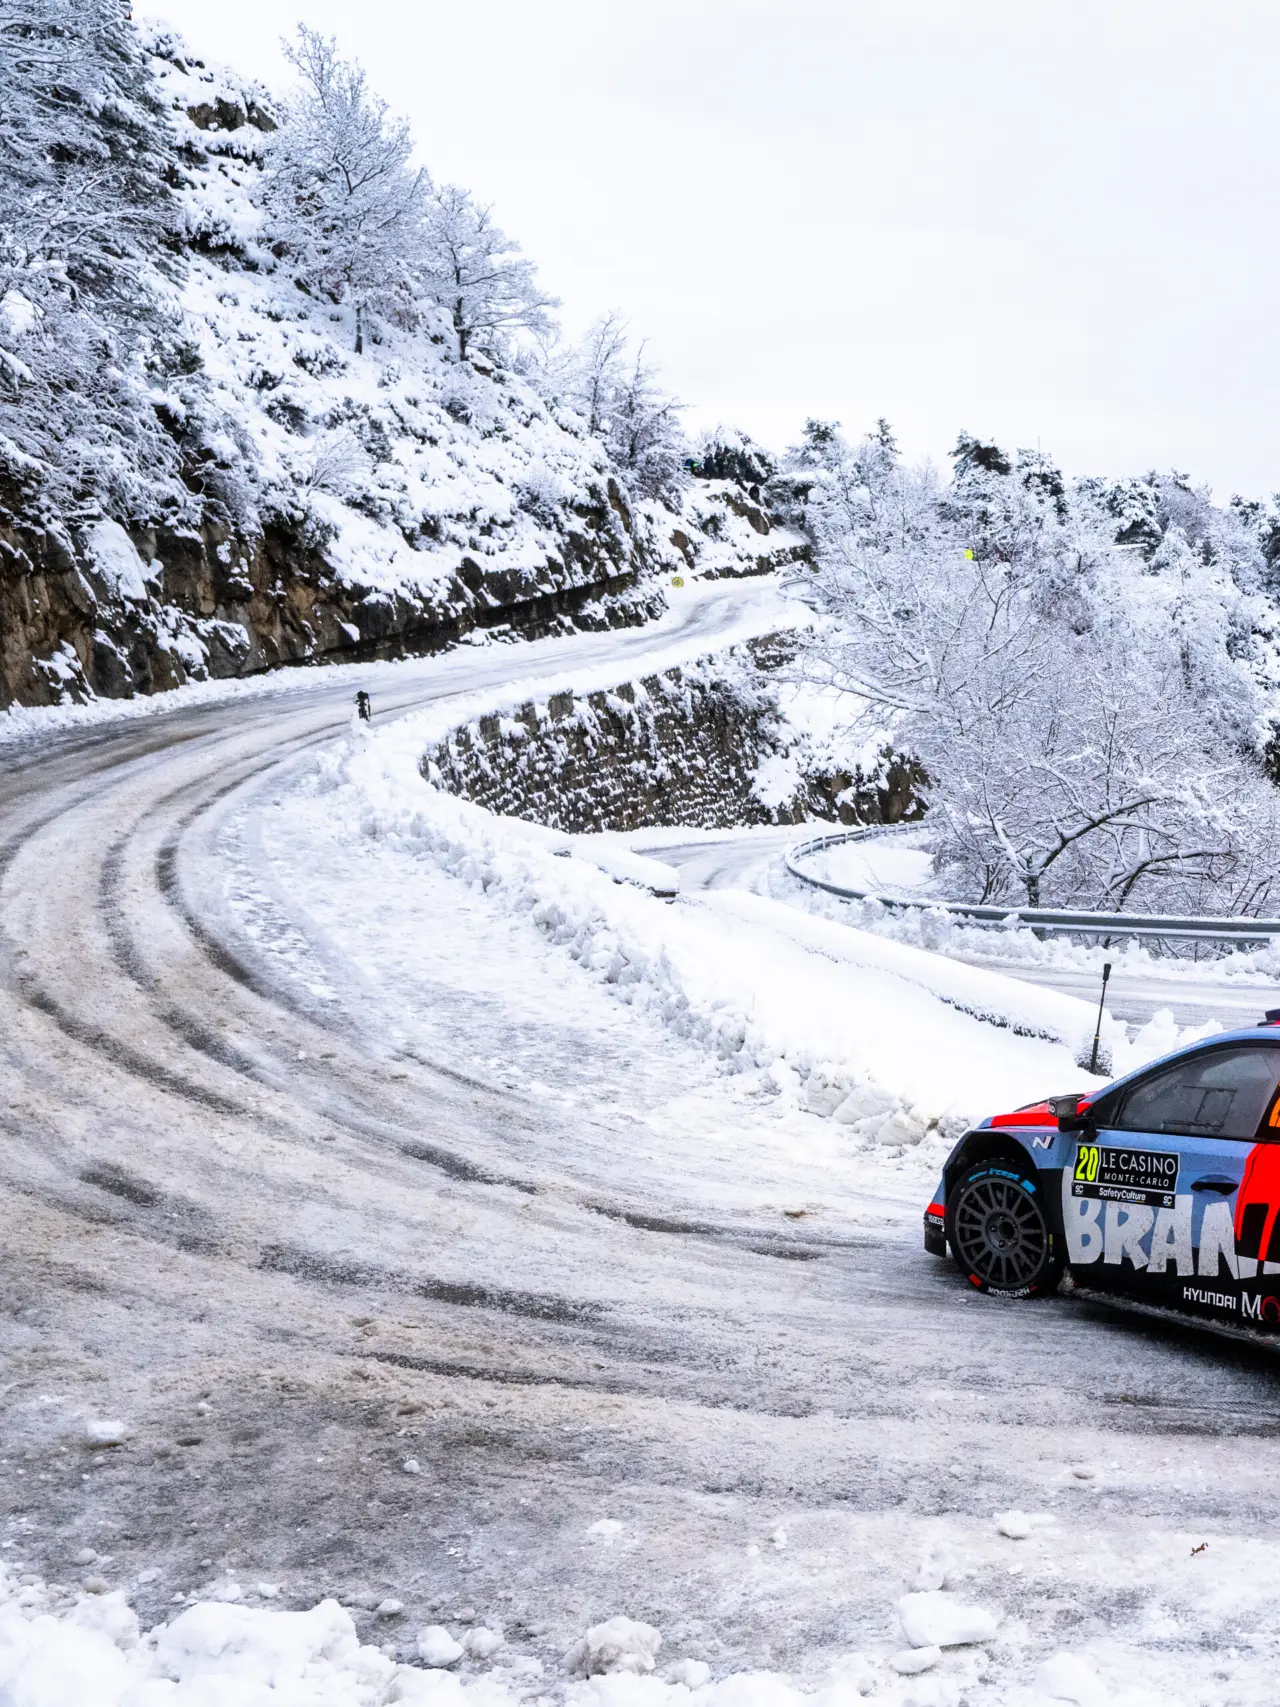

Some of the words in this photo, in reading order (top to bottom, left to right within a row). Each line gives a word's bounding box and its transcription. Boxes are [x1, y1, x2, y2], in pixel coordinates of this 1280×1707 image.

[1075, 1146, 1099, 1181] 20
[1102, 1151, 1117, 1169] LE
[1119, 1154, 1176, 1175] CASINO
[1075, 1185, 1084, 1194] SC
[1098, 1187, 1147, 1201] SafetyCulture
[1163, 1195, 1173, 1205] SC
[1183, 1286, 1237, 1310] HYUNDAI
